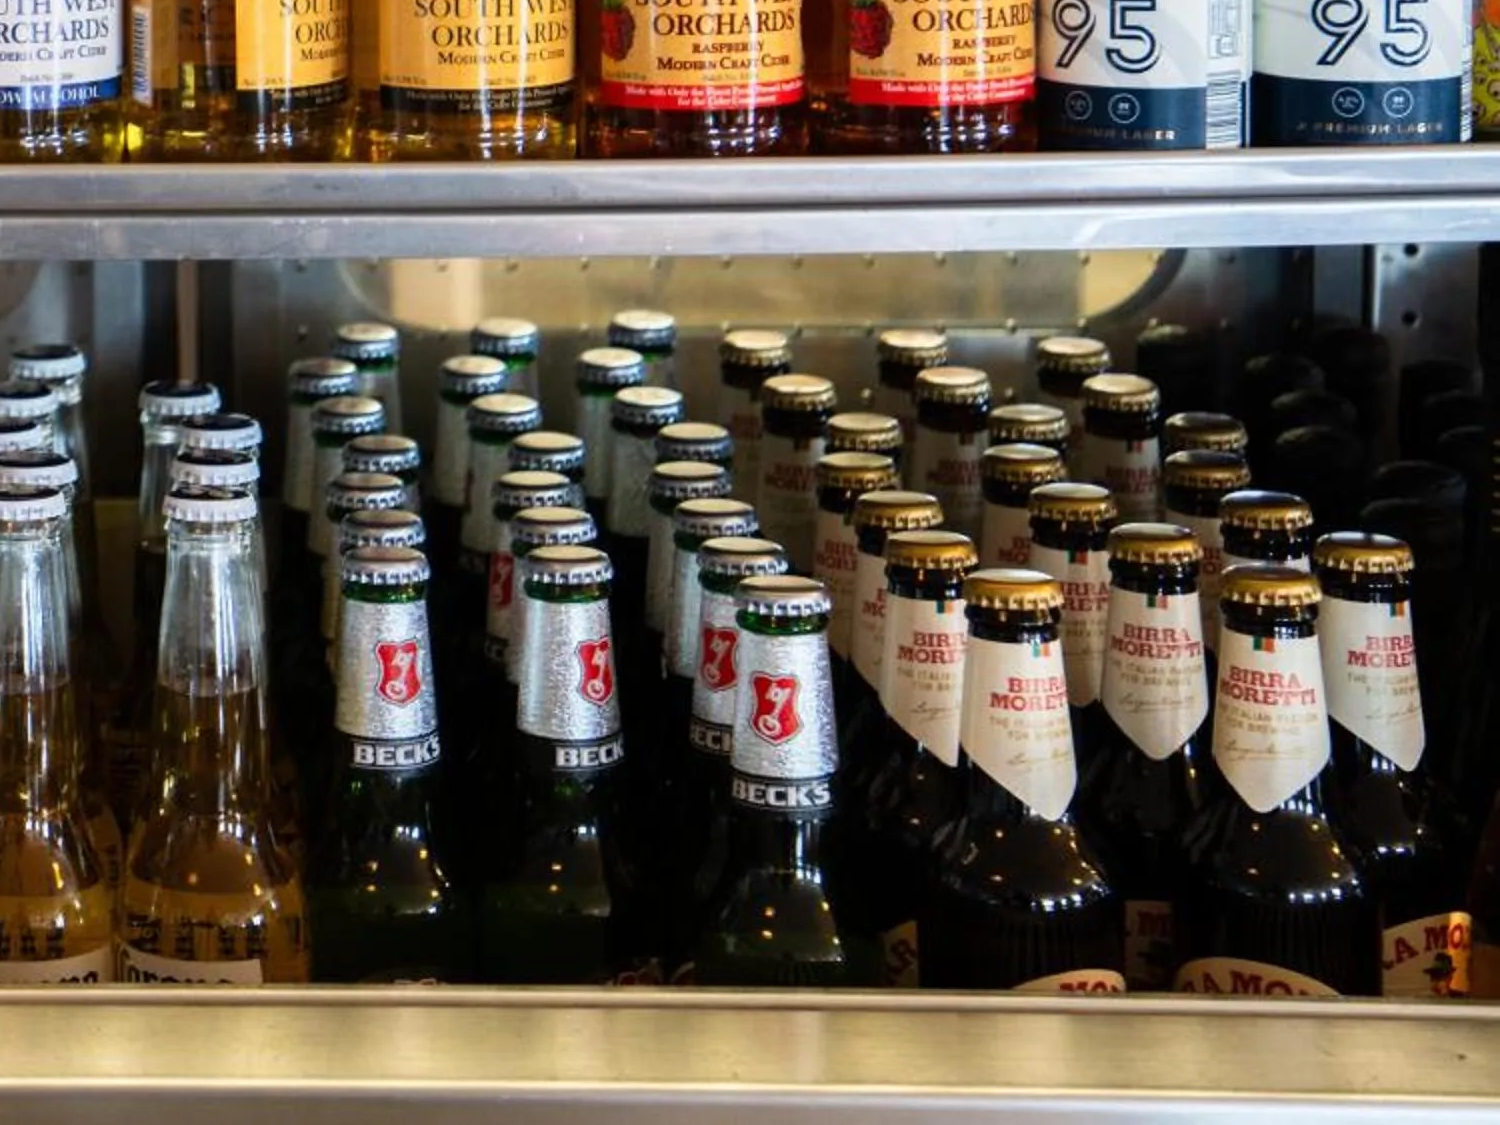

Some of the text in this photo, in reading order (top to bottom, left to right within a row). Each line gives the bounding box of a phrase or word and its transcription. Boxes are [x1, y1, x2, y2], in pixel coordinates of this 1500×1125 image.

[431, 19, 569, 49] ORCHARDS
[652, 7, 796, 37] ORCHARDS
[692, 38, 764, 55] RASPBERY
[952, 34, 1016, 50] RASBERRY
[31, 83, 100, 104] ALOHOL
[1124, 622, 1193, 643] BIRRA
[1110, 635, 1201, 659] MORETTI
[1230, 664, 1302, 689] BIRRA
[1219, 680, 1317, 706] MORETTI
